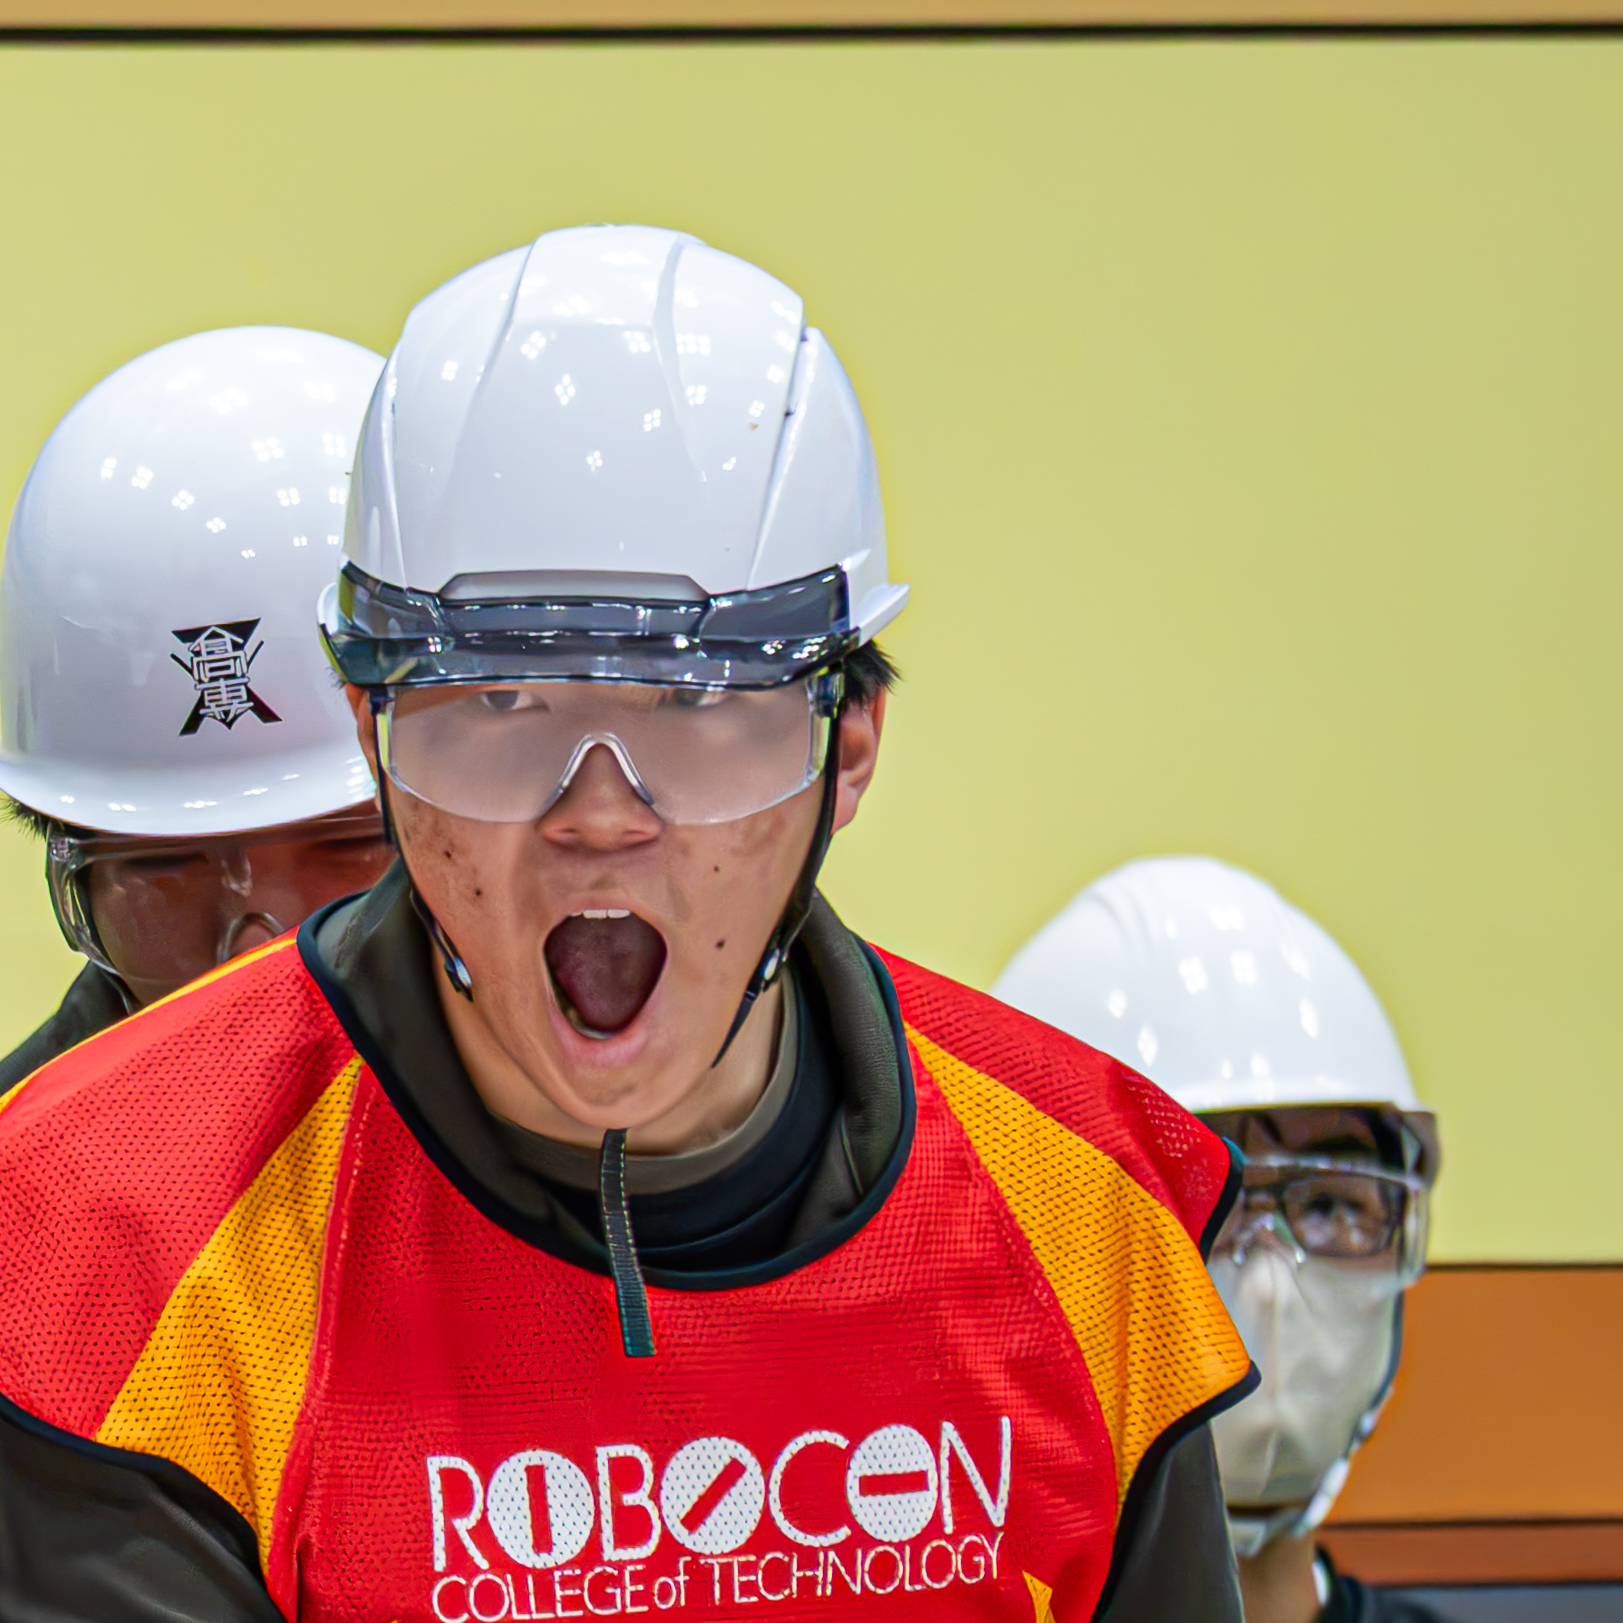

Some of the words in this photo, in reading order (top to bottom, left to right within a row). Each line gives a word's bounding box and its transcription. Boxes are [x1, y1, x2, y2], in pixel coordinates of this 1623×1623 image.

[425, 1415, 1012, 1573] ROBOCON
[654, 1556, 690, 1611] of
[696, 1531, 1006, 1607] TECHNOLOGY
